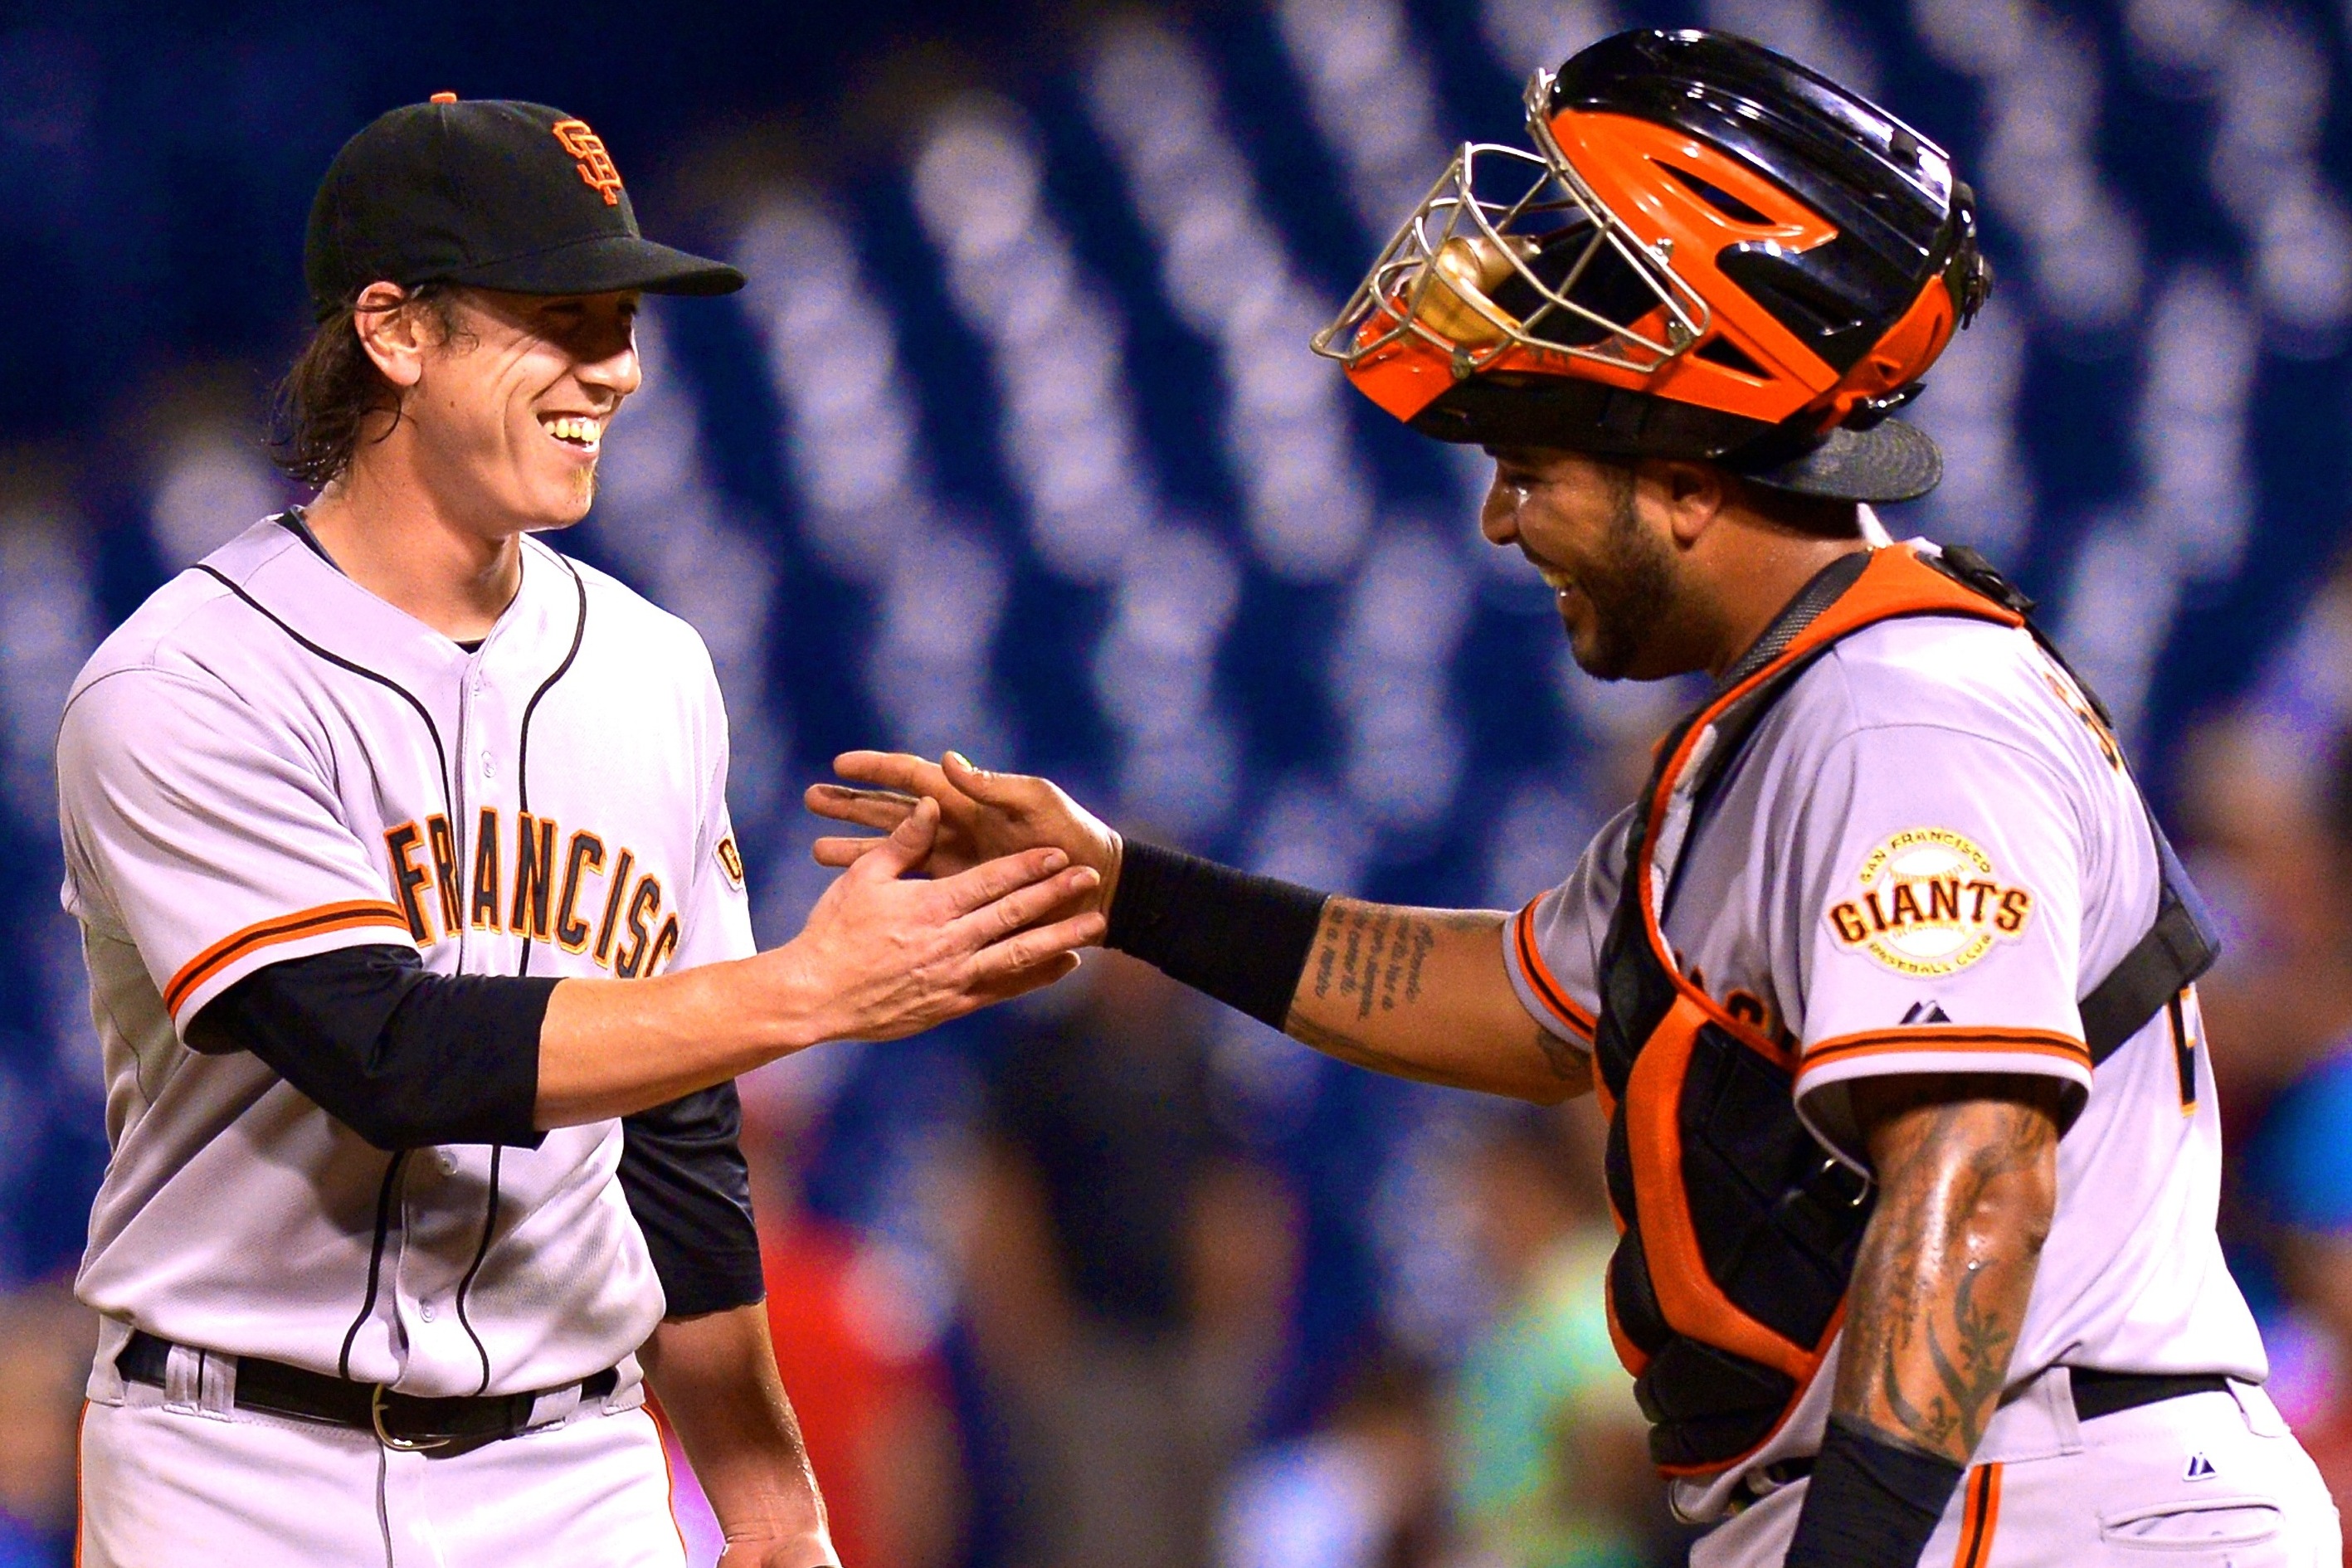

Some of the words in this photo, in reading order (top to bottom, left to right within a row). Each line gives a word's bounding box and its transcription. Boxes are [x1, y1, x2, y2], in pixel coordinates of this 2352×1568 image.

[1859, 850, 1887, 884] SAN
[1890, 830, 1992, 874] FRANCISCO
[1829, 875, 2031, 944] GIANTS
